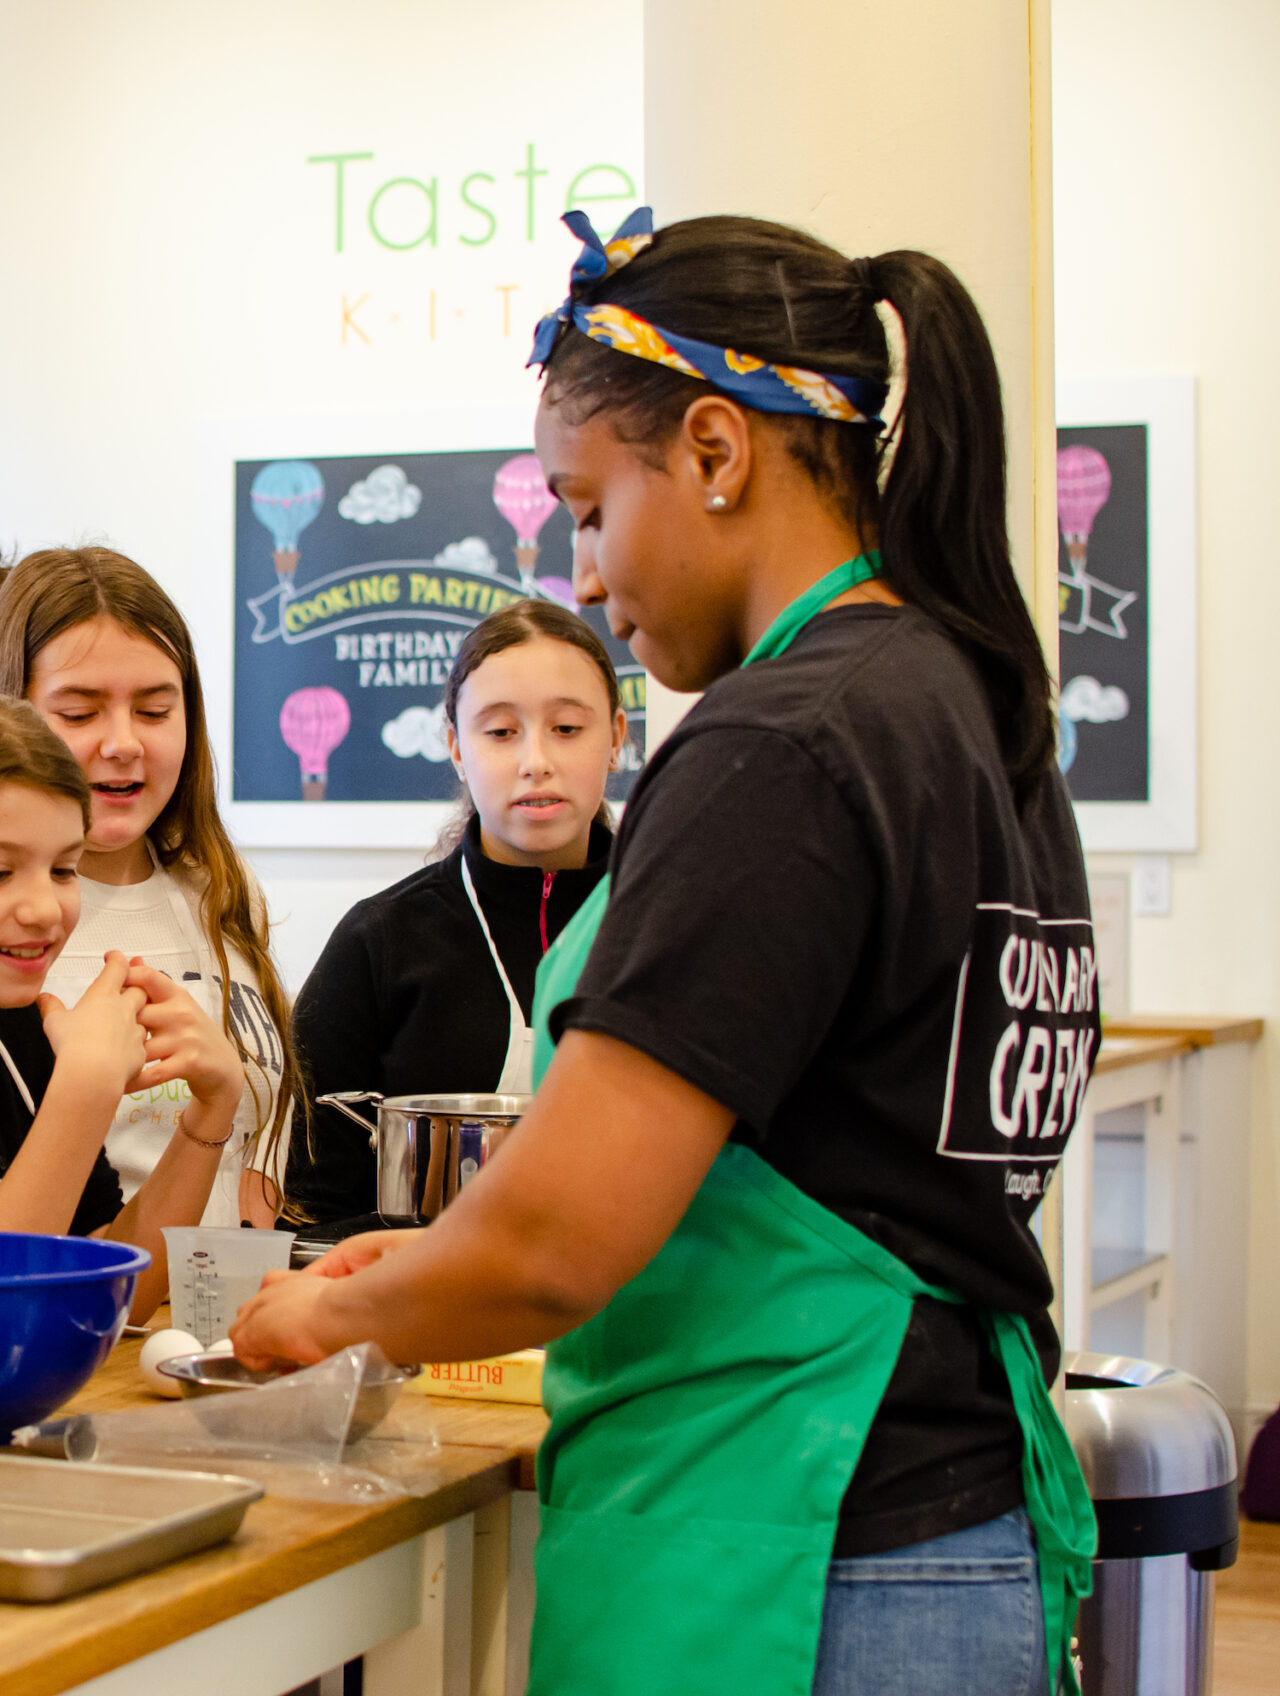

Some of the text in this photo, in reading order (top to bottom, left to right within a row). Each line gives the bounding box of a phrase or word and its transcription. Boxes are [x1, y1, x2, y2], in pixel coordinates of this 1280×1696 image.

[307, 143, 637, 254] Taste
[285, 573, 400, 632] COOKING
[335, 630, 470, 661] BIRTHDAY
[430, 1360, 503, 1385] BUTTER
